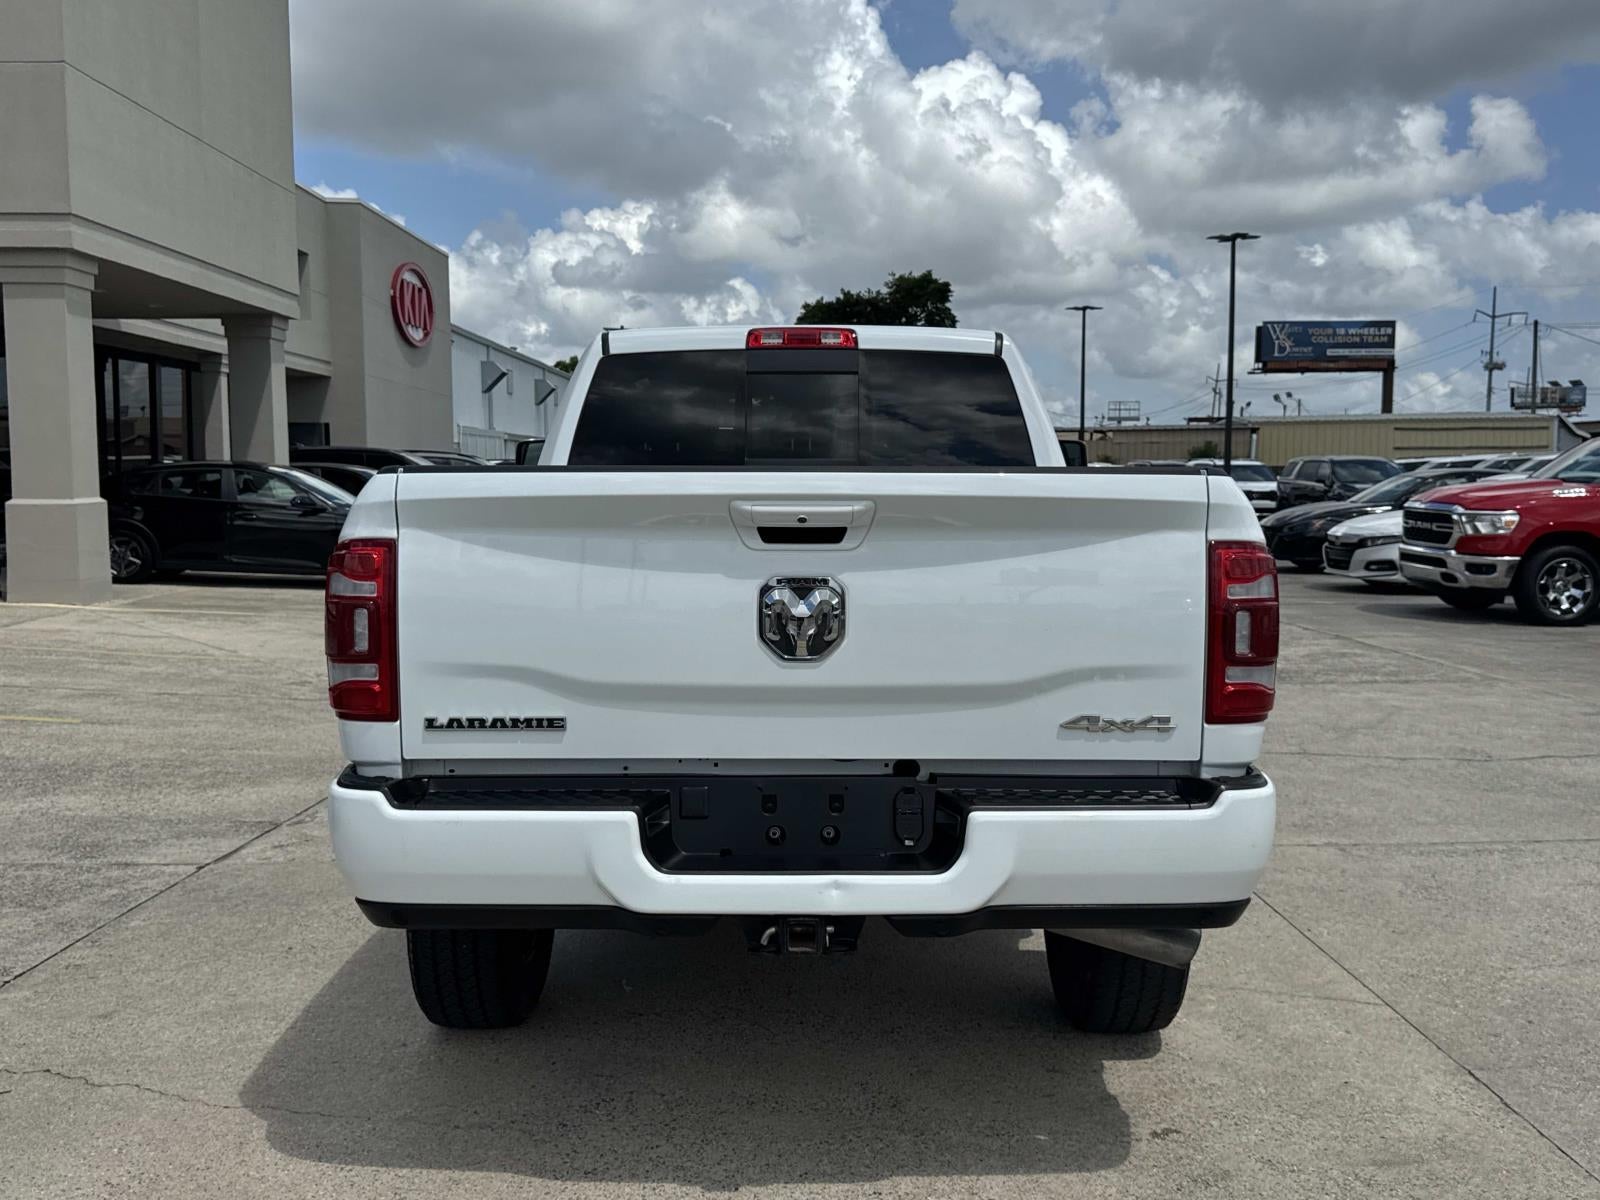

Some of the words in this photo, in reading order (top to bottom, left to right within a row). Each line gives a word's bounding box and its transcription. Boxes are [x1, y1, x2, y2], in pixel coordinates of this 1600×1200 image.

[403, 279, 430, 331] KIA
[1308, 327, 1333, 335] YOUR
[1336, 327, 1345, 335] 18
[1347, 327, 1393, 335] WHEELER
[1311, 335, 1360, 343] COLLISION
[1361, 335, 1387, 343] TEAM
[776, 577, 830, 586] RAM
[424, 717, 567, 731] LARAMIE
